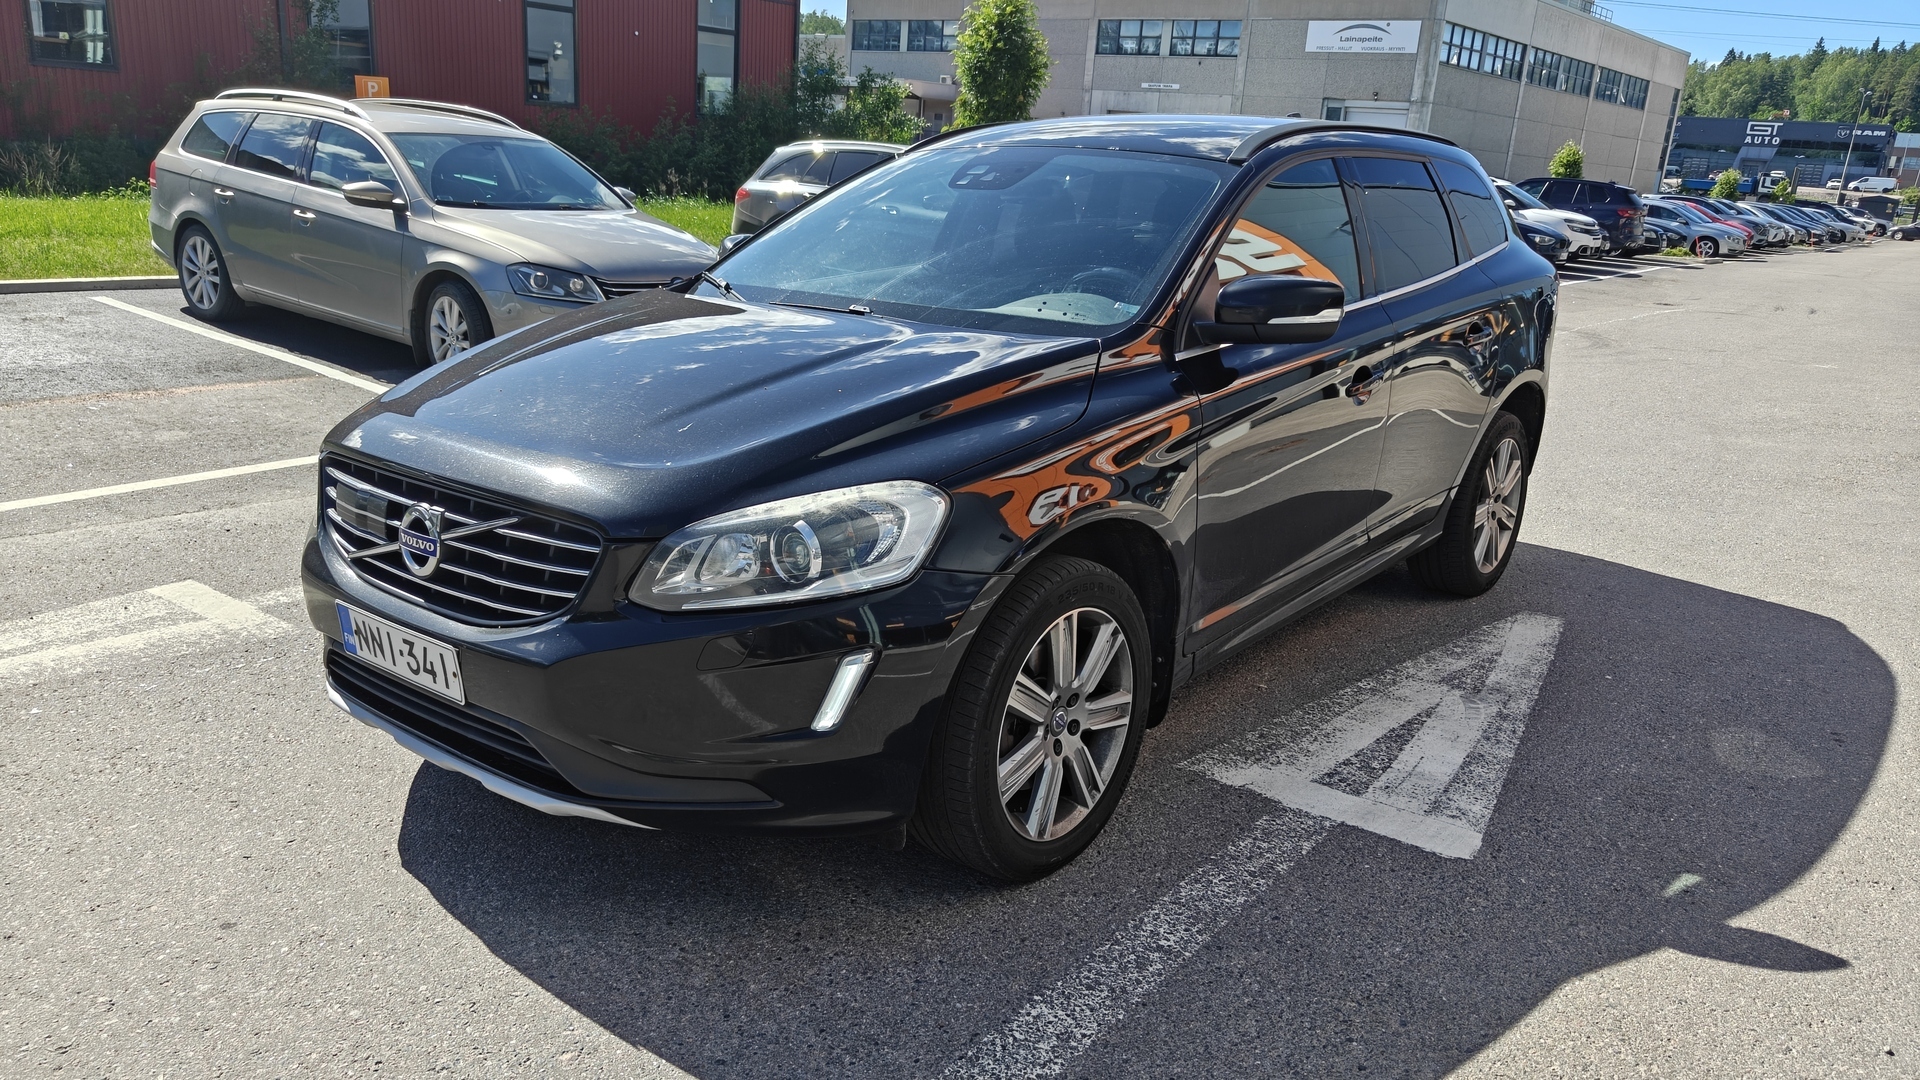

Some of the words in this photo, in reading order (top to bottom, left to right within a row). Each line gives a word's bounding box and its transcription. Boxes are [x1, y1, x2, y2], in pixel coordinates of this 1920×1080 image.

[1339, 35, 1383, 44] Lainapeite
[367, 81, 379, 98] P
[1746, 121, 1784, 136] GT
[1852, 129, 1887, 137] RAM
[1743, 135, 1780, 145] AUTO
[400, 532, 435, 552] VOLVO
[343, 632, 356, 646] FIN
[354, 617, 450, 690] NNI-341
